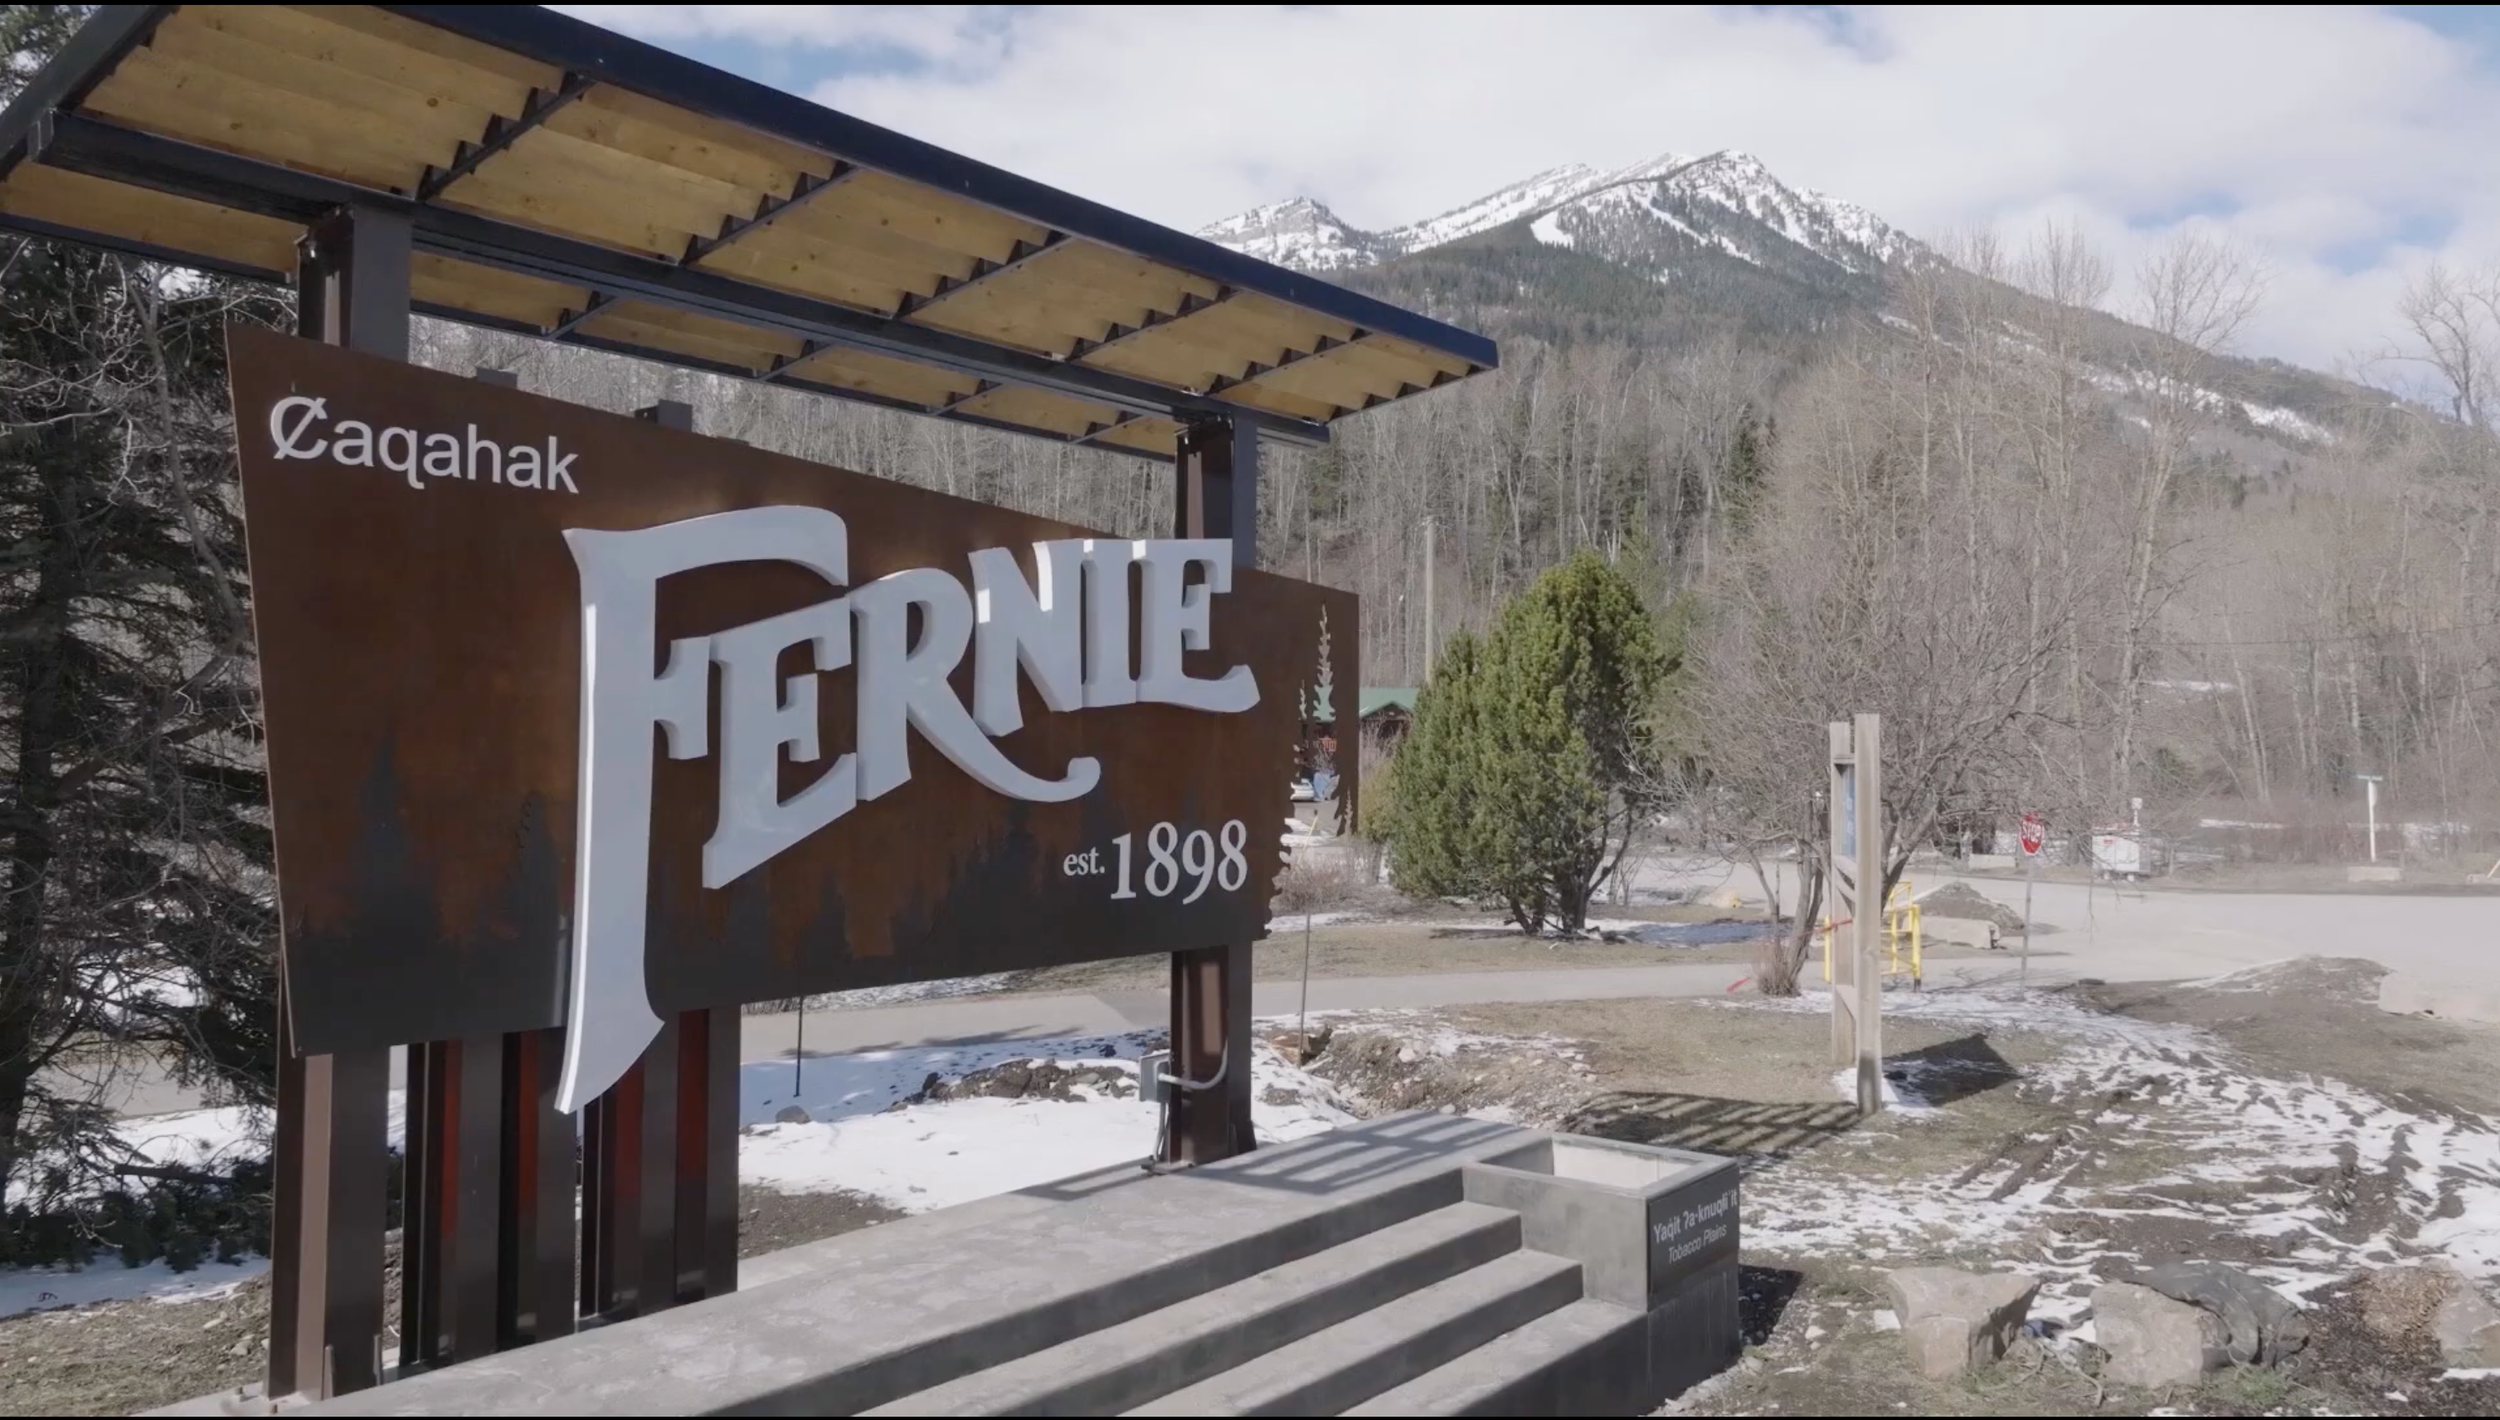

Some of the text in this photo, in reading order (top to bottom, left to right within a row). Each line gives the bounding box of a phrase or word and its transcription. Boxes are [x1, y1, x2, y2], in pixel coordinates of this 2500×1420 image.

[554, 504, 1260, 1115] FERNIE
[1063, 819, 1248, 905] est. 1898
[1668, 1223, 1728, 1264] Tobacco Plains
